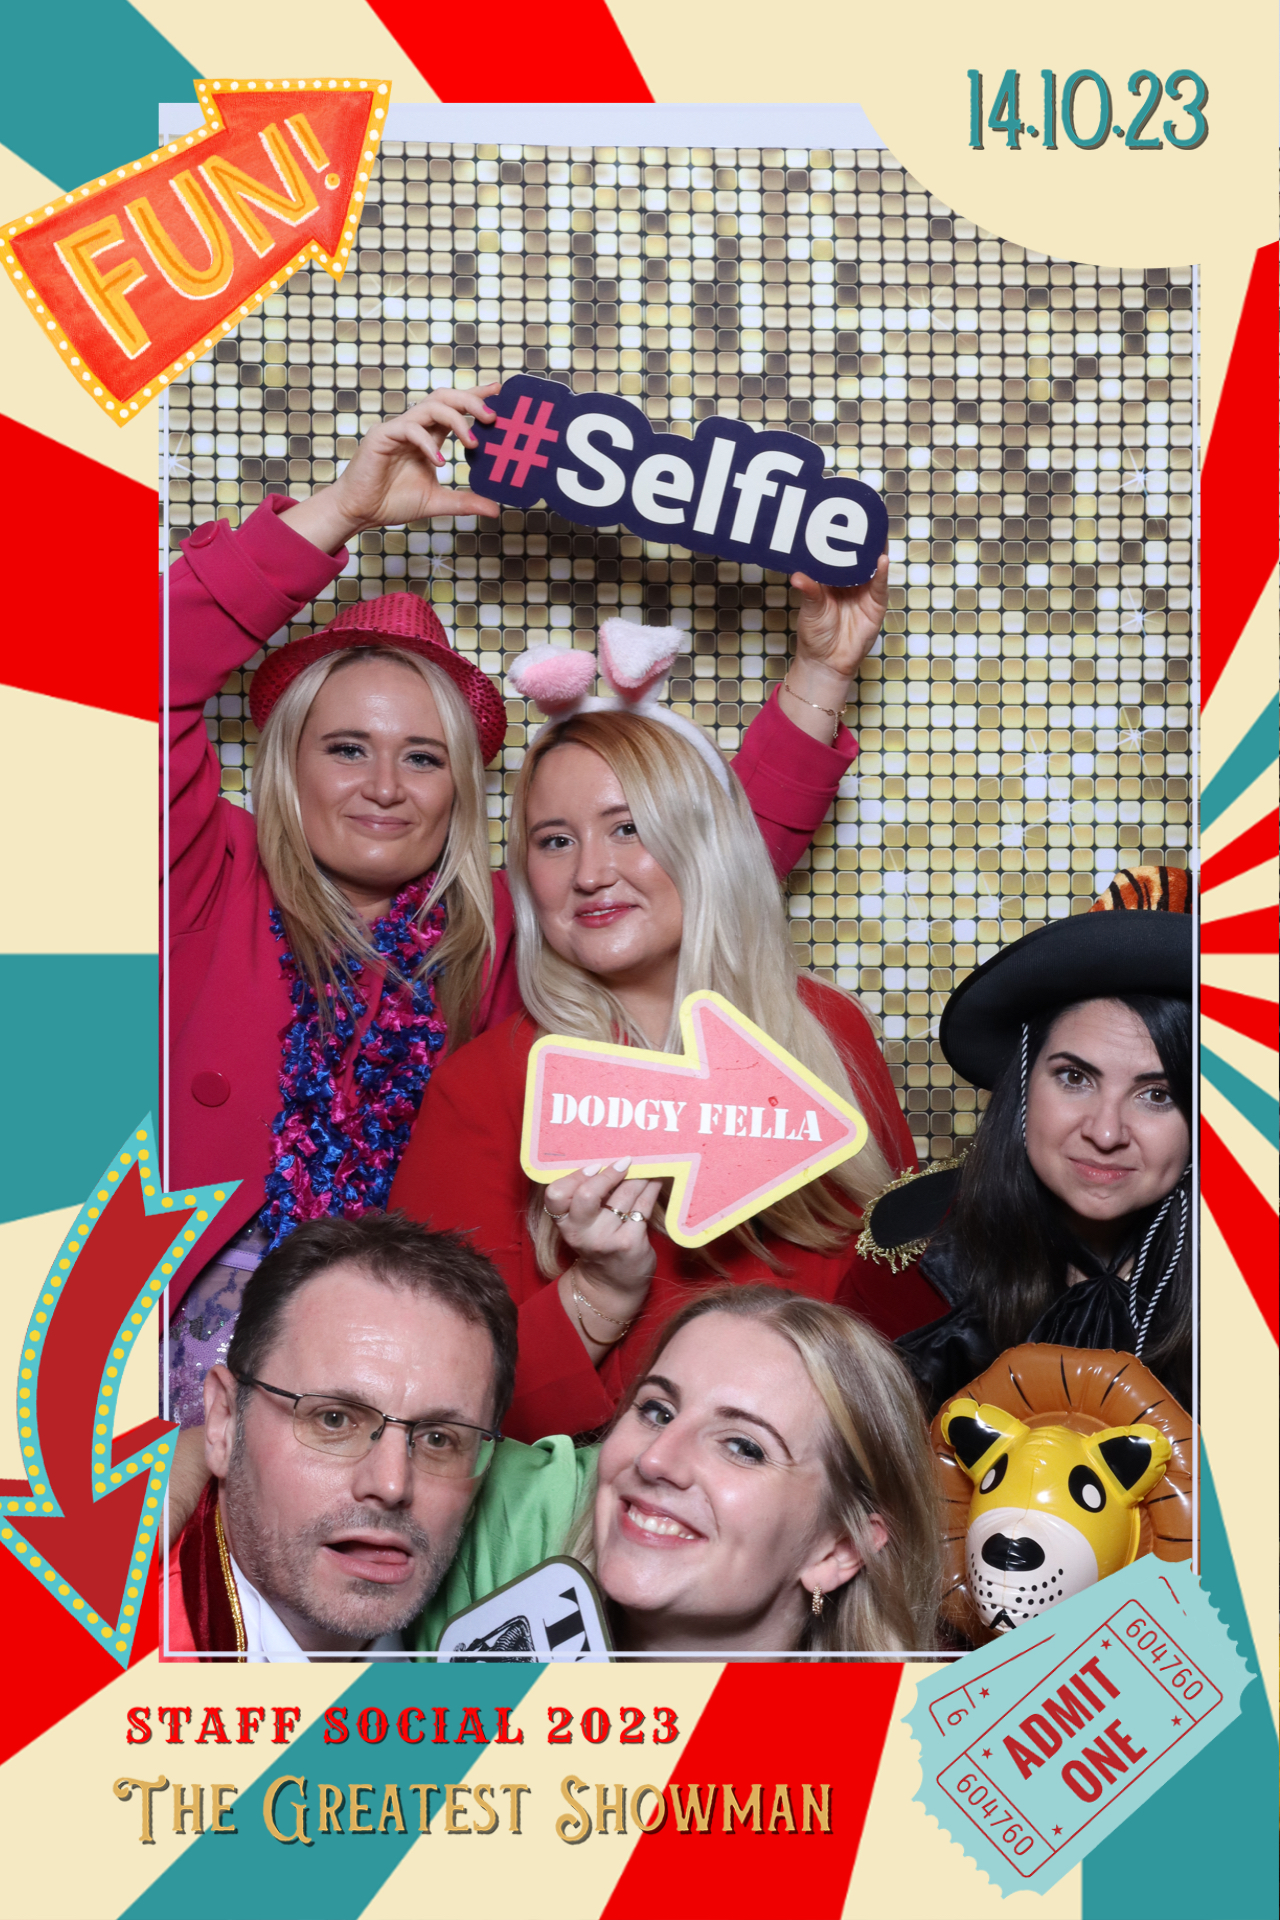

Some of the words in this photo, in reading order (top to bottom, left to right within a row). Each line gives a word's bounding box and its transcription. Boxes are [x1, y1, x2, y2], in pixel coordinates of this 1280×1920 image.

[484, 395, 869, 568] #Selfie
[550, 1093, 687, 1132] DODGY
[697, 1103, 823, 1142] FELLA
